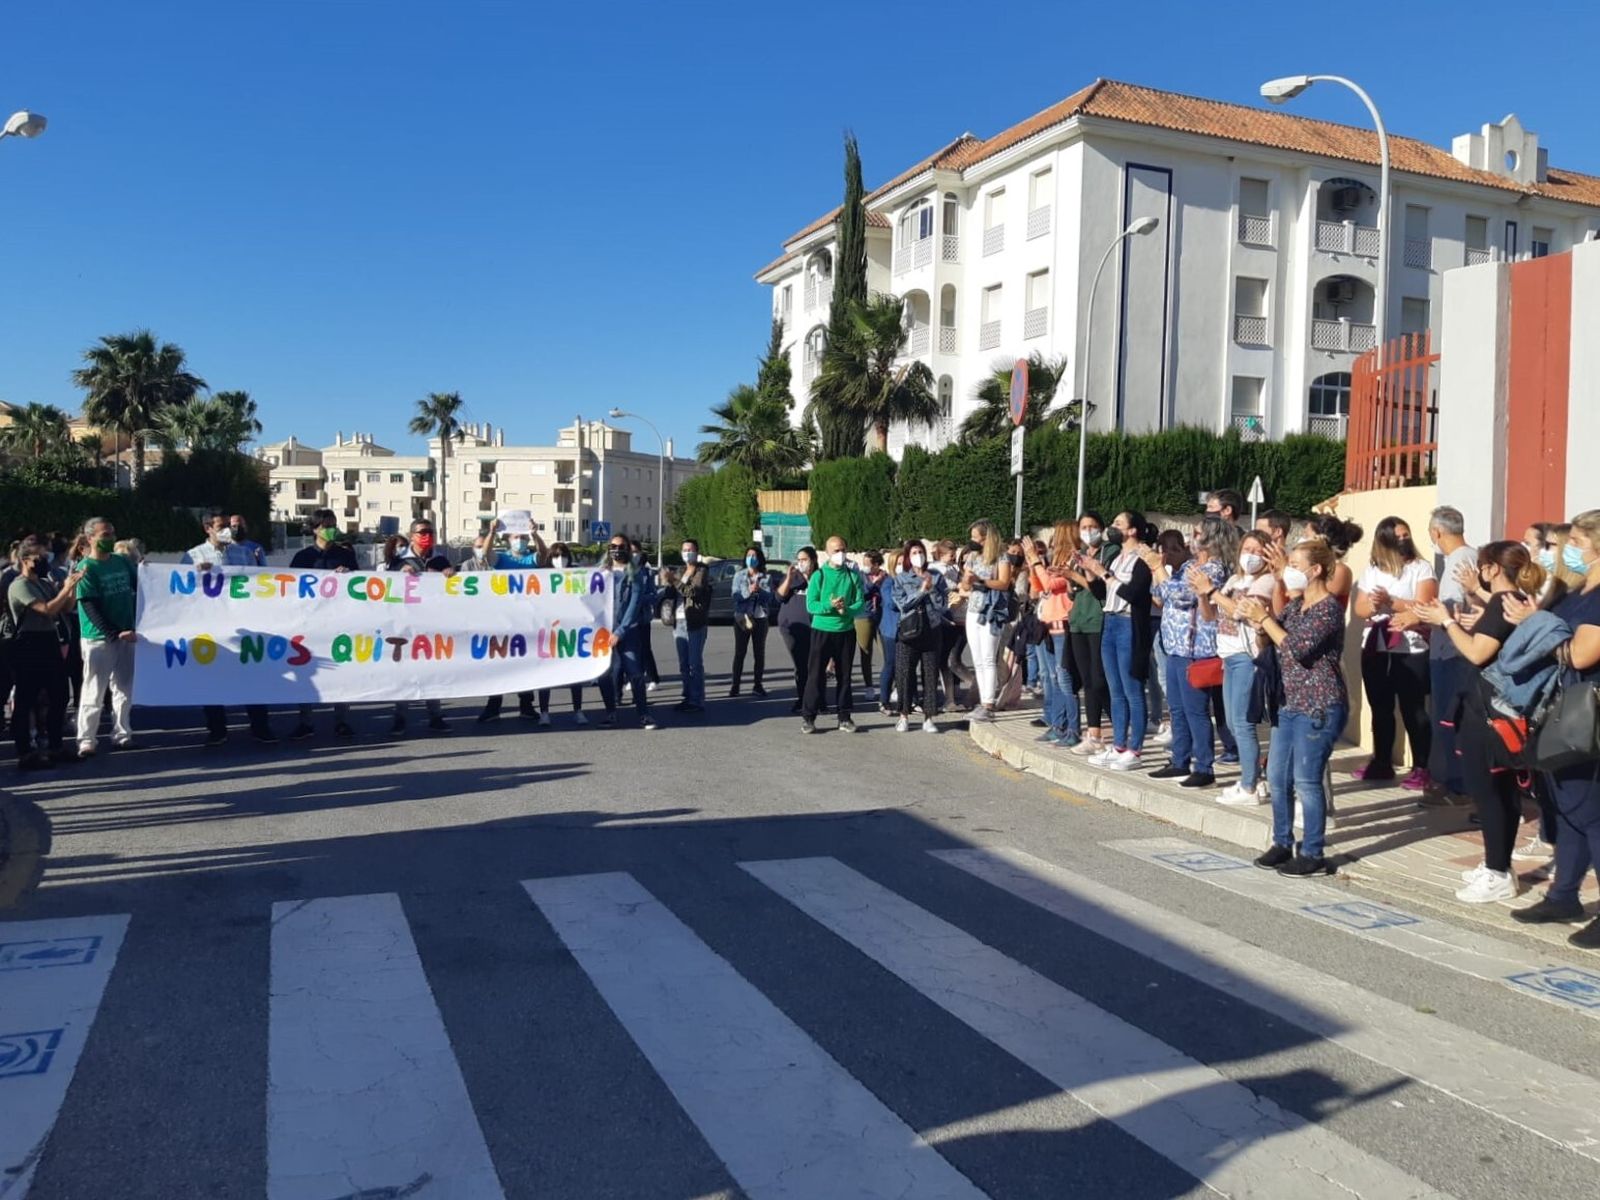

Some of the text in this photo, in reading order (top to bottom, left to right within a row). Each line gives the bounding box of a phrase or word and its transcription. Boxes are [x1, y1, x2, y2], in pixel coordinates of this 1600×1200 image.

[170, 570, 338, 598] NUESTRO
[347, 575, 421, 604] COLE
[445, 575, 479, 595] ES
[490, 574, 541, 595] UNA
[164, 633, 217, 669] NO
[239, 634, 312, 666] NOS
[471, 633, 527, 660] UNA
[537, 619, 612, 659] LÍNEA
